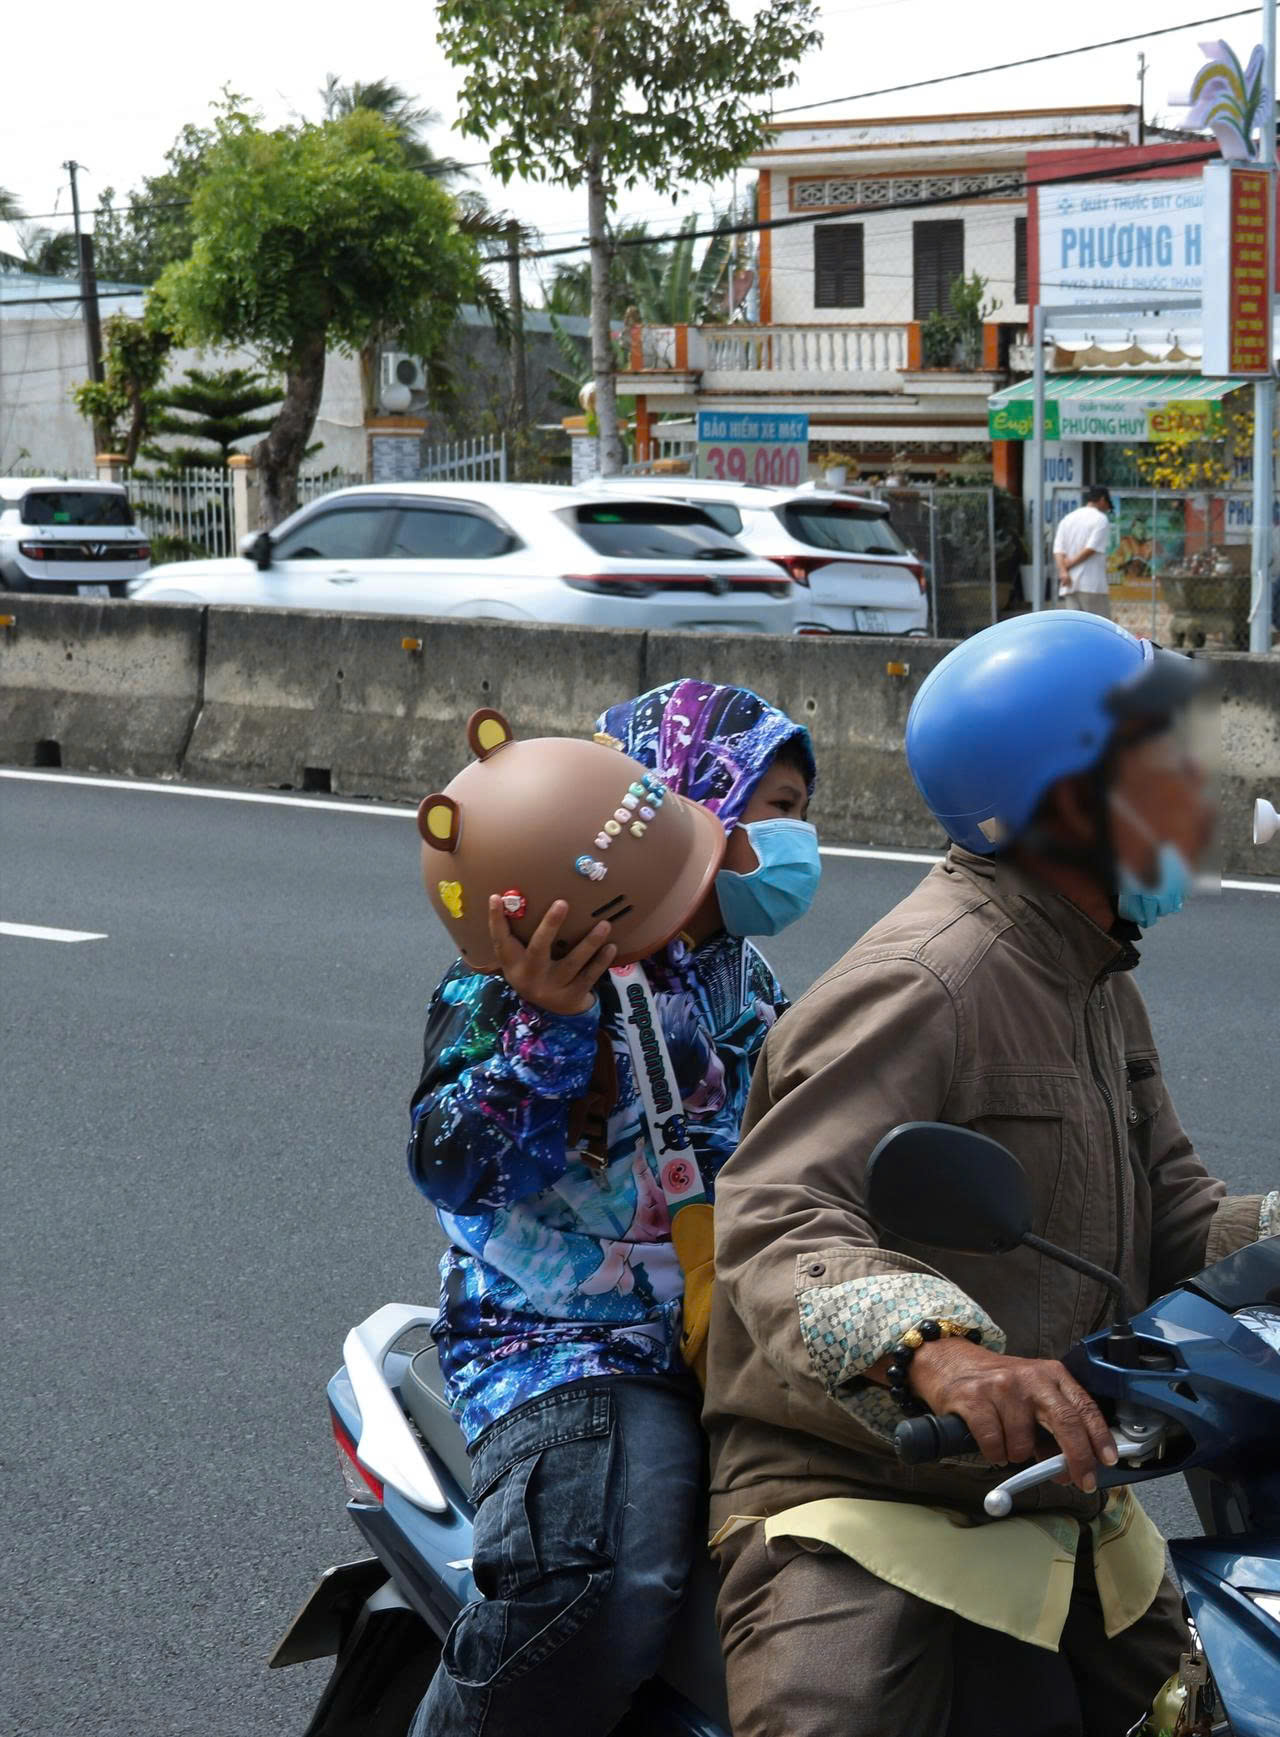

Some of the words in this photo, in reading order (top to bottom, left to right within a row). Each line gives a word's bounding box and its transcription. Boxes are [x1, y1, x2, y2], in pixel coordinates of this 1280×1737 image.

[1061, 223, 1173, 269] PHƯƠNG
[703, 416, 727, 438] BẢO
[730, 416, 759, 438] HIỂM
[761, 422, 776, 438] XE
[1062, 416, 1117, 435] PHƯƠNG
[1118, 418, 1145, 435] HUY
[706, 447, 800, 485] 39.000
[626, 983, 674, 1115] anpanman
